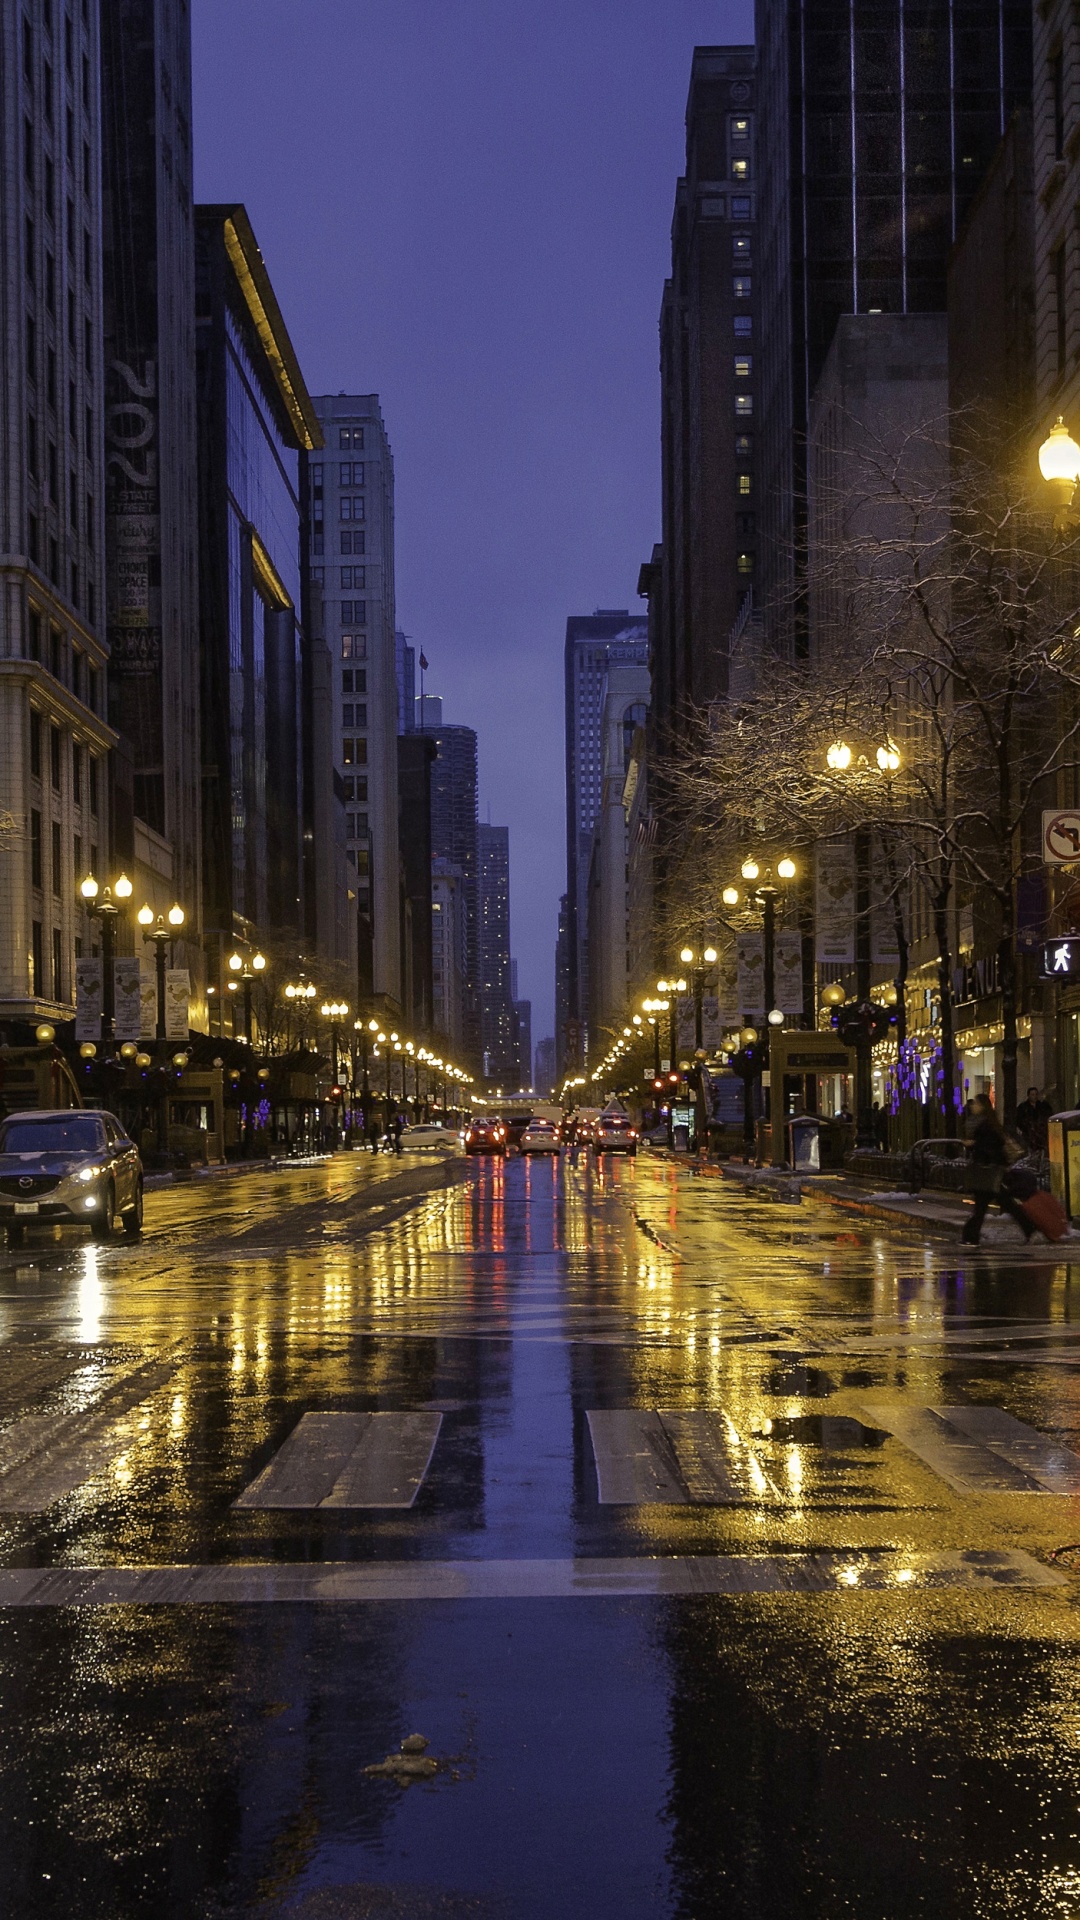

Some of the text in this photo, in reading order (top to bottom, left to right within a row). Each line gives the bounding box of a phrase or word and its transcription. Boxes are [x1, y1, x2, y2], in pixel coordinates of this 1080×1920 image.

[105, 360, 156, 486] 202
[119, 490, 157, 501] STATE
[118, 562, 148, 574] CHOICE
[119, 576, 147, 588] SPACE
